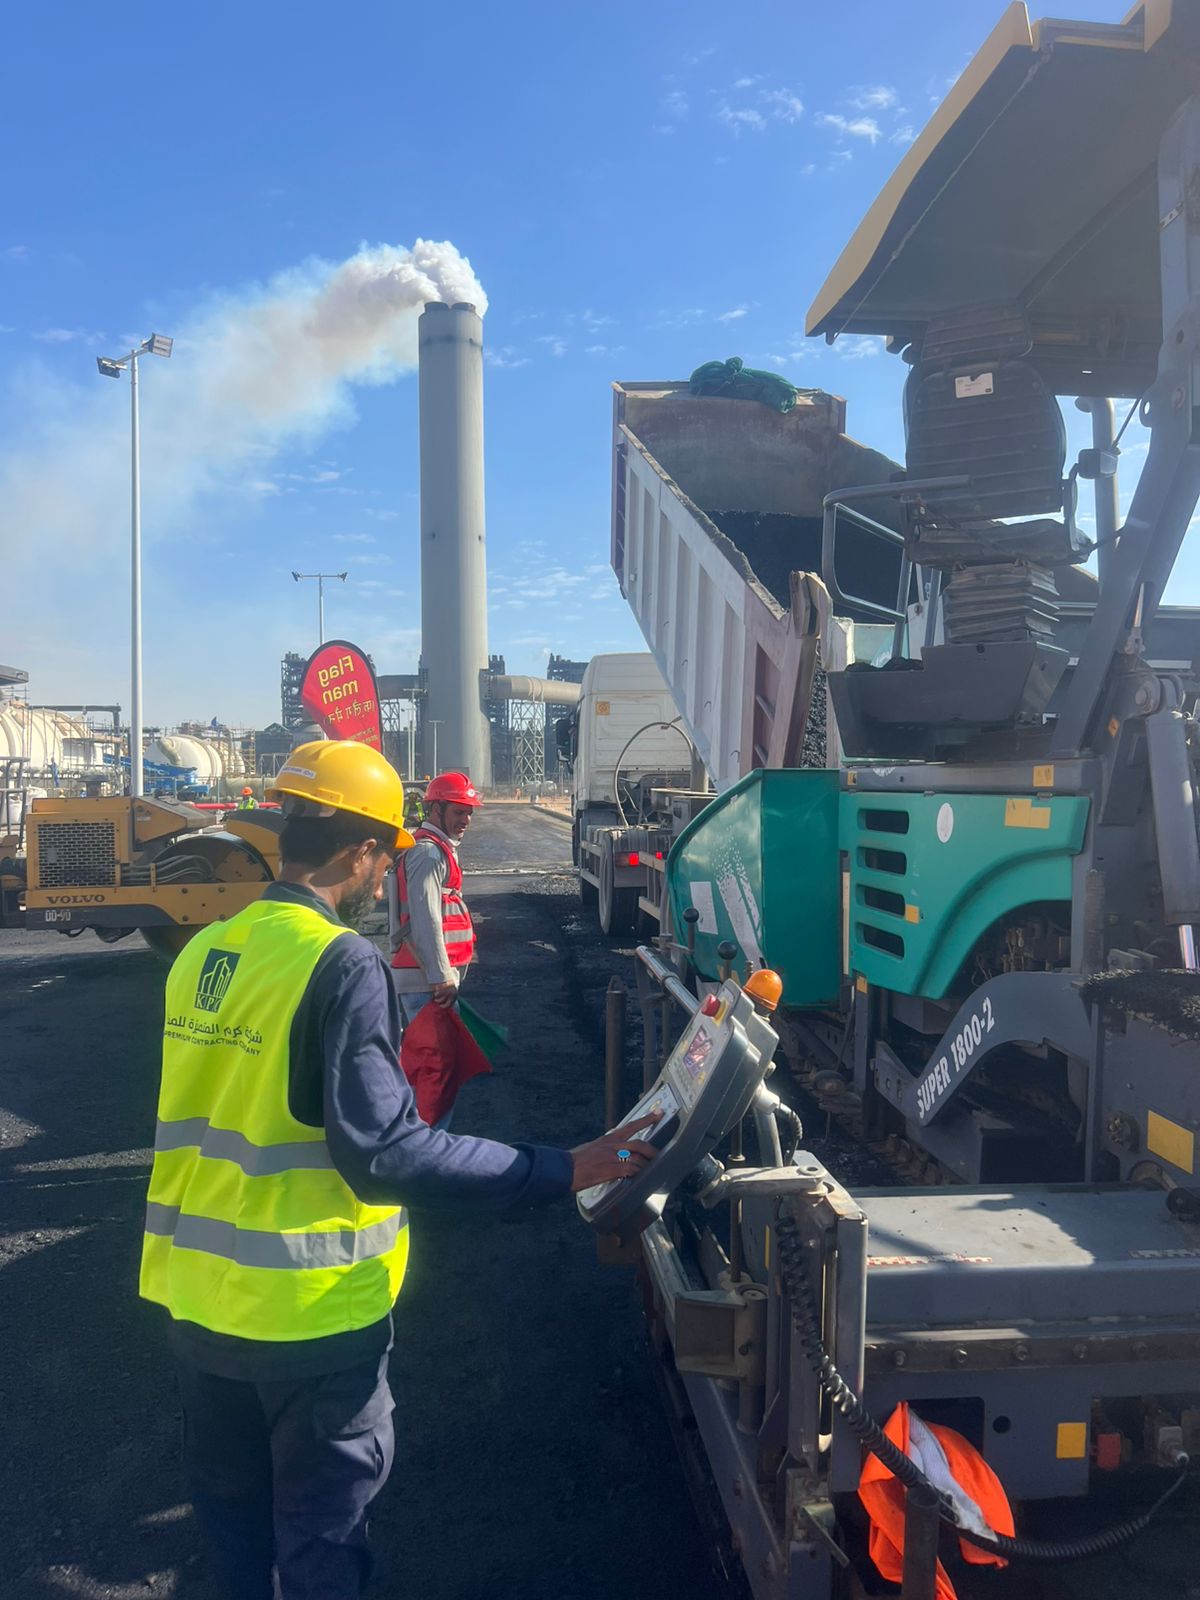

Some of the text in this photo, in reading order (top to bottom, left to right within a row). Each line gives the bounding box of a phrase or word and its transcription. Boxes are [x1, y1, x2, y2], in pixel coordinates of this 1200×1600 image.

[45, 894, 105, 904] VOLVO
[917, 996, 995, 1119] SUPER 1800-2
